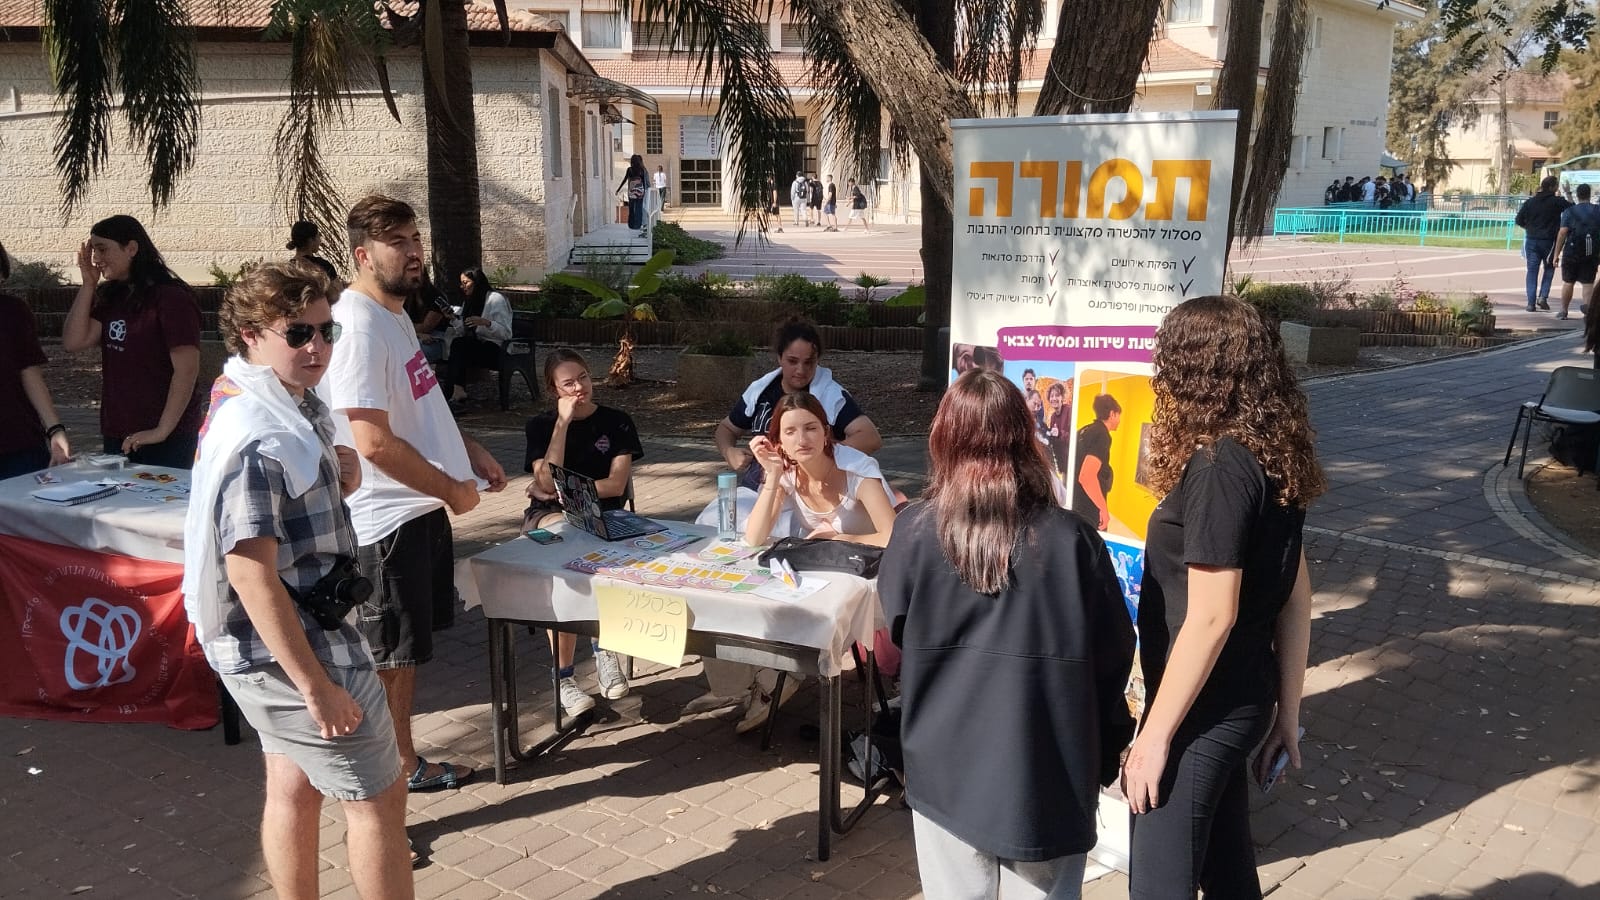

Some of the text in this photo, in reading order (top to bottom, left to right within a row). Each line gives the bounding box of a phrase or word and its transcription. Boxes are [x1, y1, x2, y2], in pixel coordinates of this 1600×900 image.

[969, 158, 1211, 221] תמורה
[967, 223, 1202, 241] מסלול להכשרה מקצועית בתחומי התרבות
[981, 252, 1045, 263] הדרכת סדנאות
[1111, 257, 1177, 271] הפקת אירועים
[1021, 274, 1045, 284] יזמות
[1067, 277, 1175, 293] אומנות פלסטית ואוצרות
[967, 290, 1044, 304] מדיה ושיווק דיגיטלי
[1088, 299, 1137, 311] ופרפורמנס
[1003, 333, 1156, 350] שנת שירות ומסלול צבאי
[625, 590, 682, 616] מסלול
[624, 616, 676, 644] תמורה
